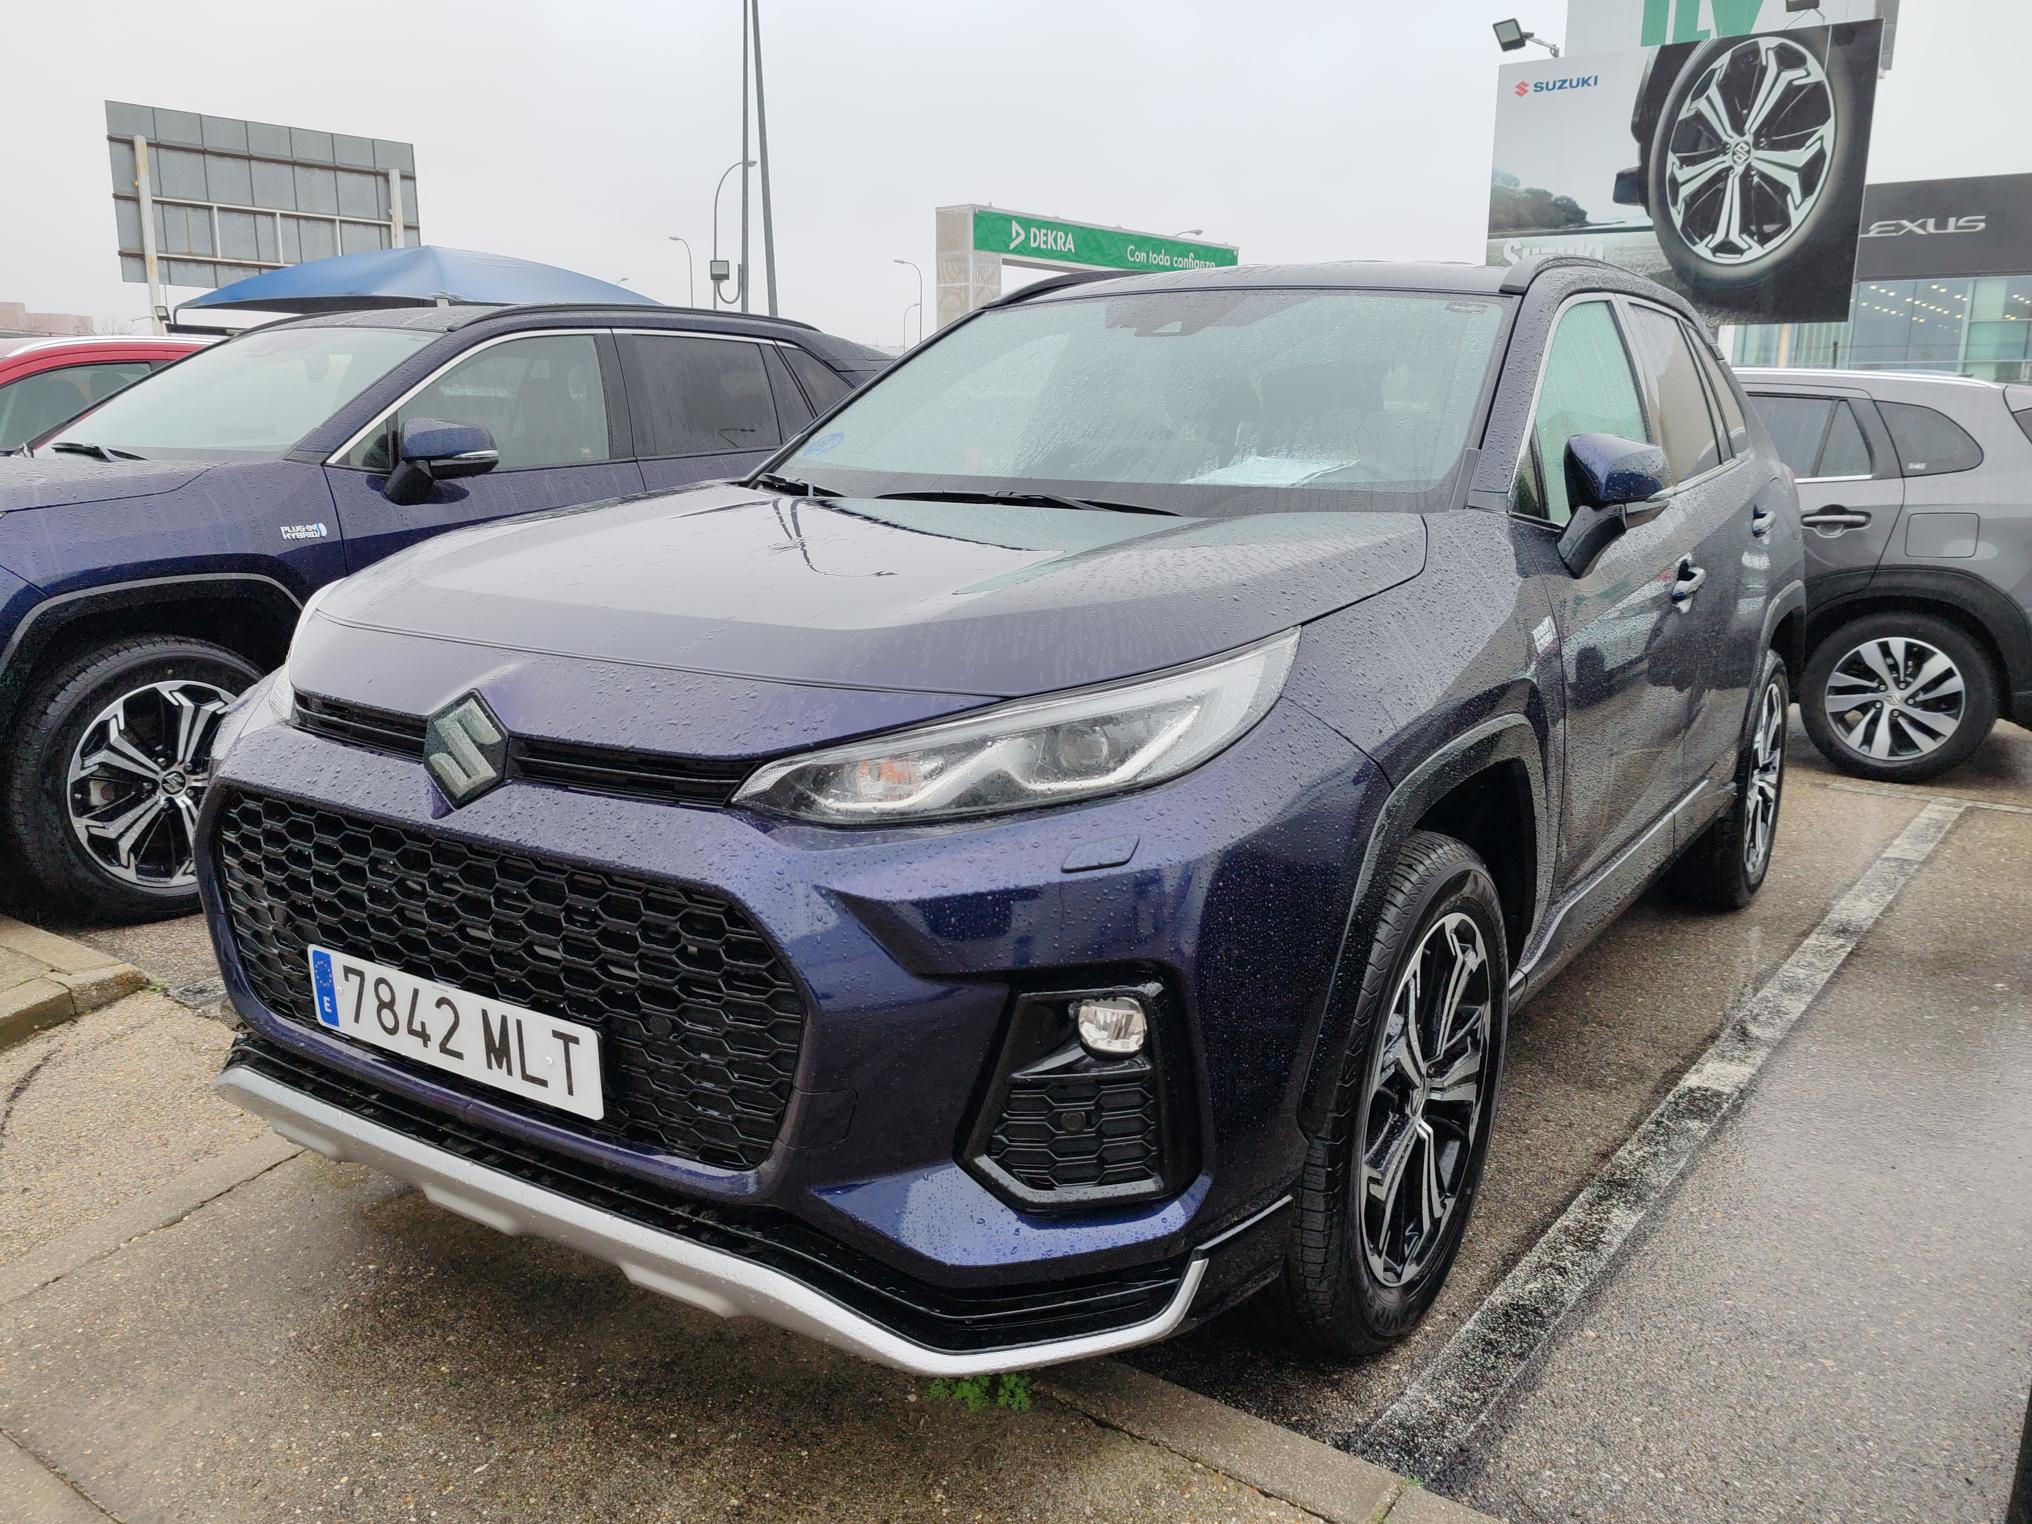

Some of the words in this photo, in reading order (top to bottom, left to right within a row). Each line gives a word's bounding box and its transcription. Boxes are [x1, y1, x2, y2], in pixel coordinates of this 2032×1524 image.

[1533, 75, 1598, 92] SUZUKI
[1859, 215, 1986, 237] EXUS
[1029, 227, 1076, 253] DEKRA
[1127, 245, 1147, 263] Con
[1149, 249, 1170, 266] toda
[1173, 252, 1216, 268] confianza
[280, 524, 316, 532] PLUG-IN
[283, 530, 320, 540] HYBRID
[323, 996, 332, 1013] E
[343, 965, 464, 1061] 7842
[481, 1008, 580, 1097] MLT
